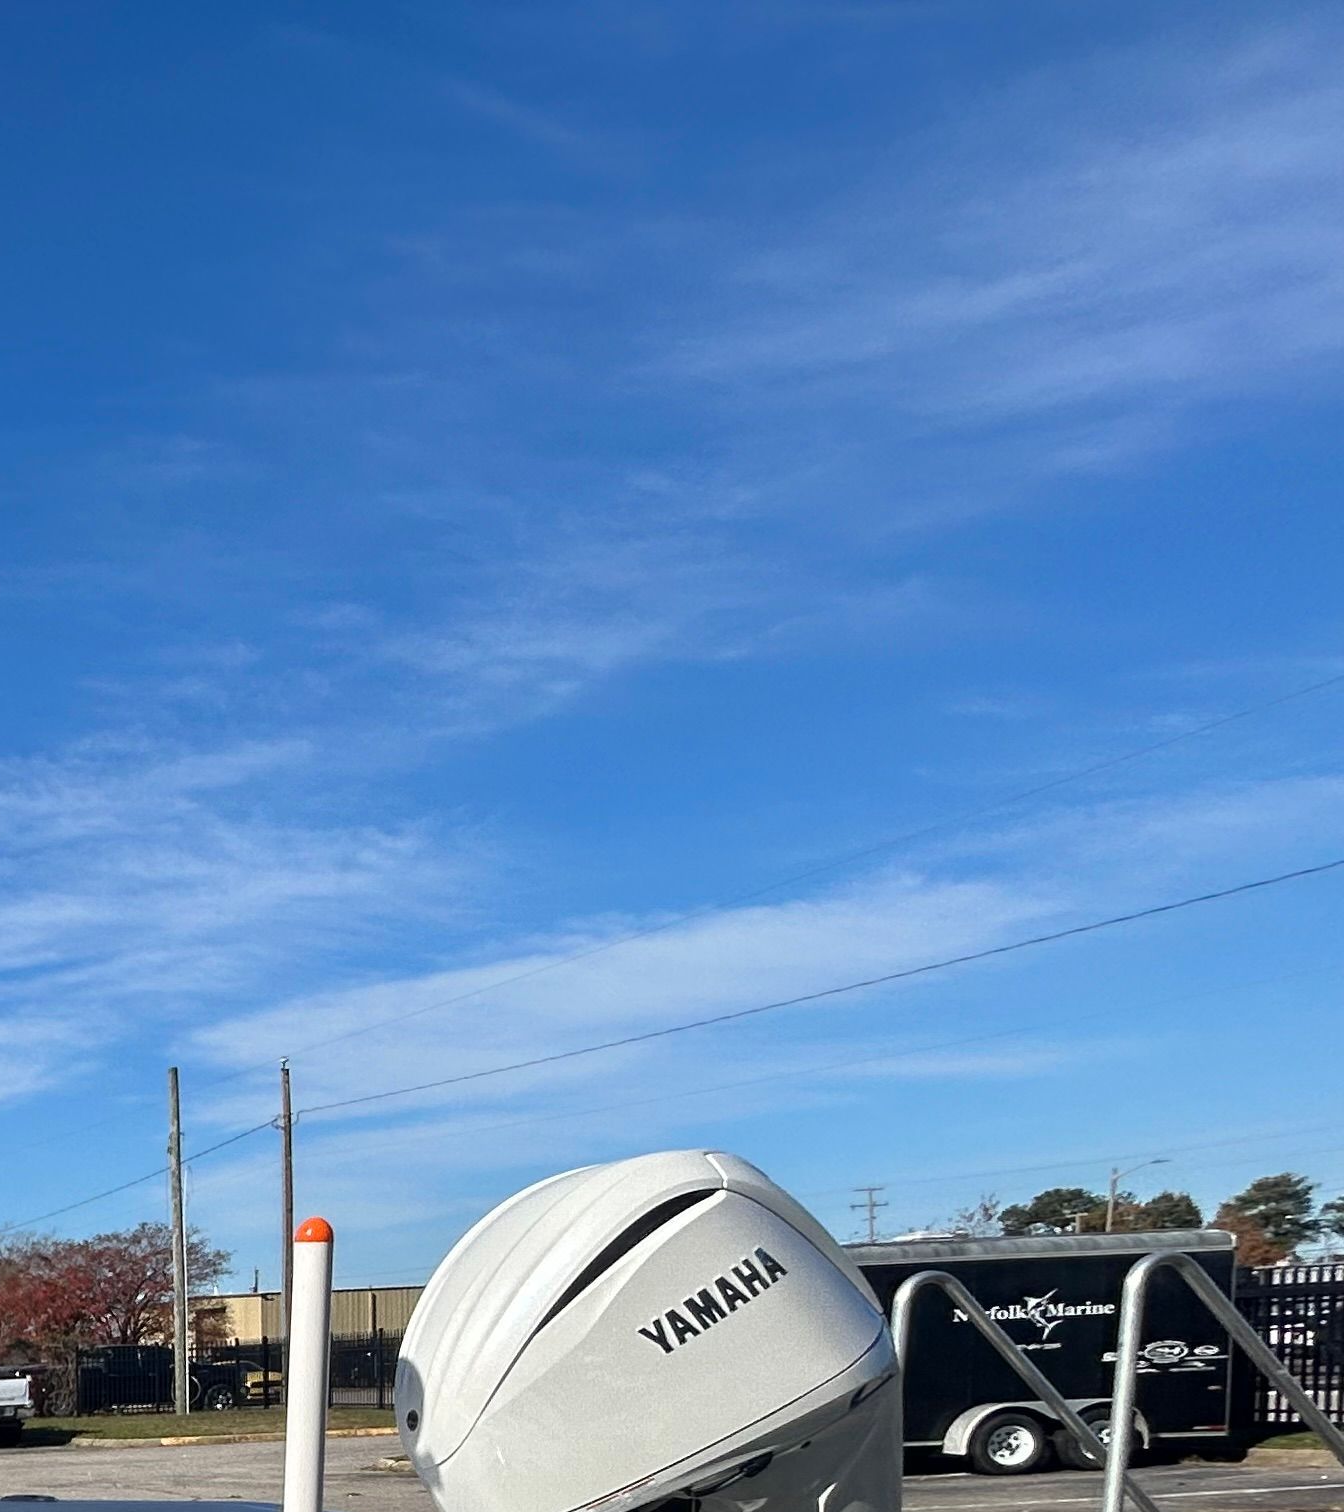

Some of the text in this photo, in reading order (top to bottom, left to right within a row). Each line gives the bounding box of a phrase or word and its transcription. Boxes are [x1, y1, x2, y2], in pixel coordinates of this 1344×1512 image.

[638, 1247, 788, 1354] YAMAHA
[952, 1301, 1115, 1322] Nfolk Marine
